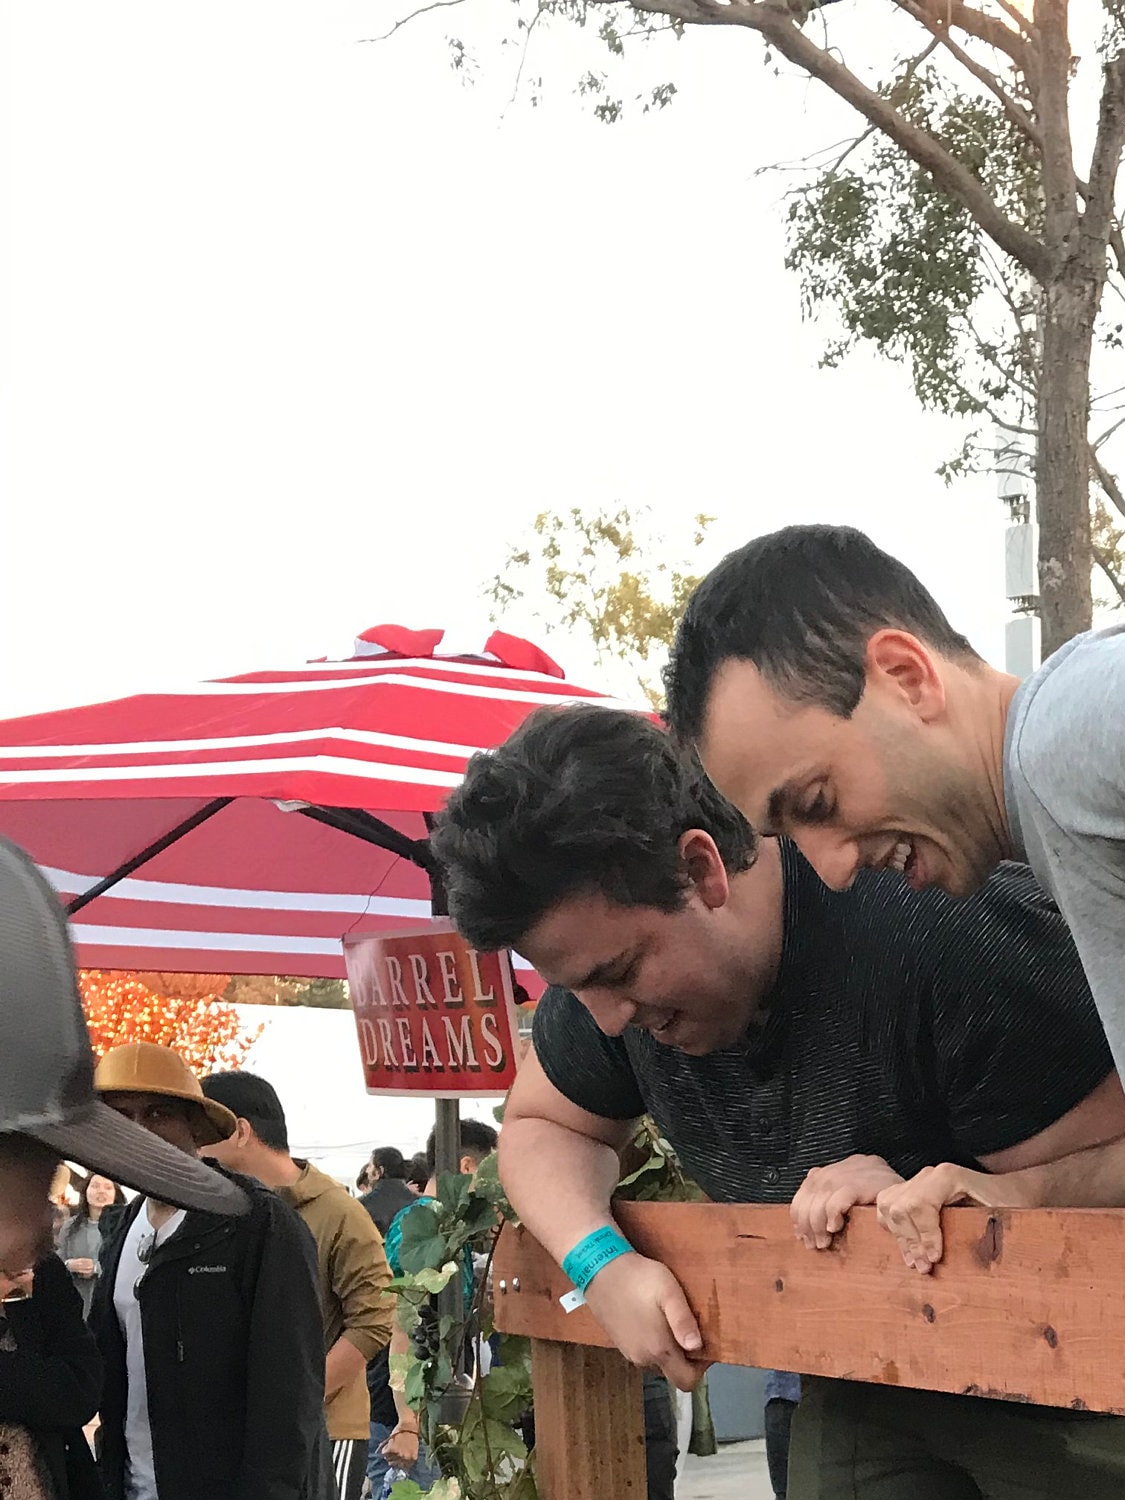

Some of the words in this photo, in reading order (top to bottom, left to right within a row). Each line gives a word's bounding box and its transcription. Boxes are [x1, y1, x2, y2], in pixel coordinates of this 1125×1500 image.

[351, 950, 494, 1007] BARREL
[359, 1013, 505, 1069] DREAMS
[582, 1245, 618, 1278] Internal
